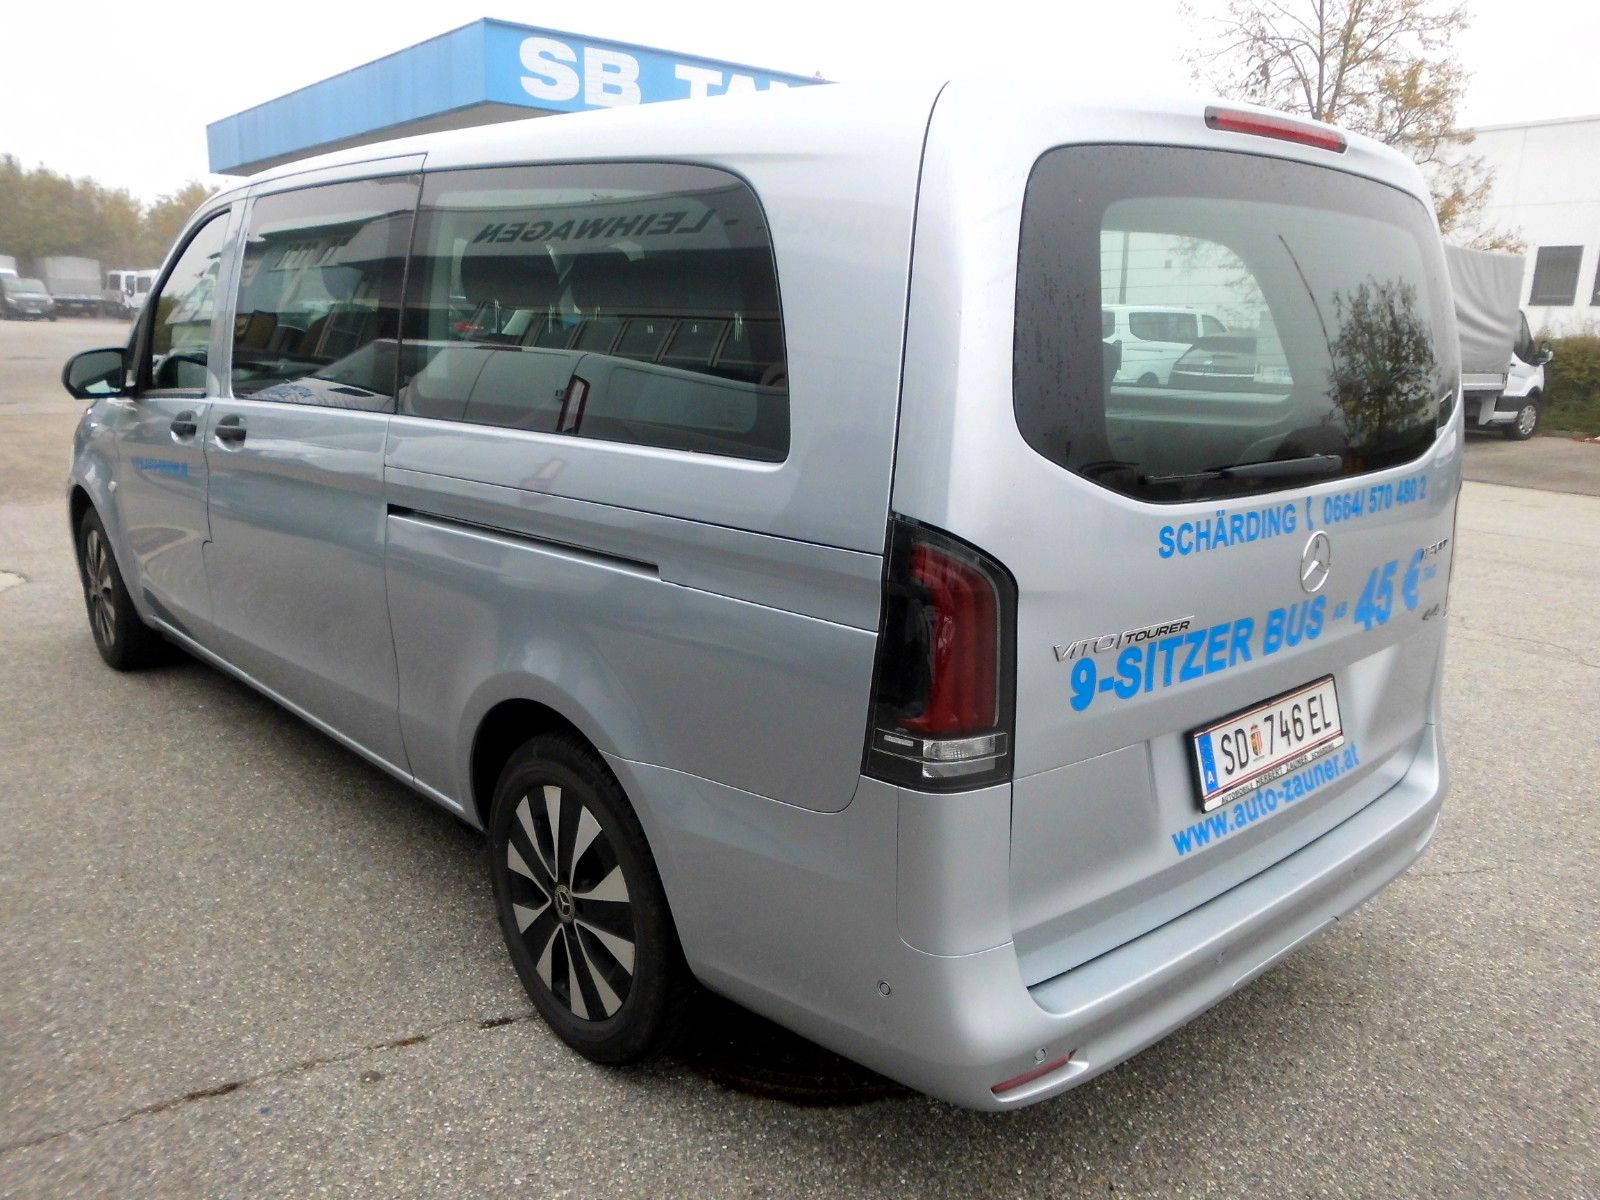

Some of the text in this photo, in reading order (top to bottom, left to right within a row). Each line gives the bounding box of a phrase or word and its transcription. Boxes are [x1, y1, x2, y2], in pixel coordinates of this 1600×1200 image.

[519, 37, 642, 107] SB
[1158, 503, 1297, 559] SCHÄRDING
[1369, 484, 1392, 514] 570
[1053, 620, 1191, 662] VITO TOURER
[1070, 617, 1255, 712] 9-SITZER
[1262, 595, 1328, 657] BUS
[1354, 560, 1399, 632] 45
[1220, 728, 1250, 776] SD
[1172, 740, 1361, 856] www.auto-zauner.at
